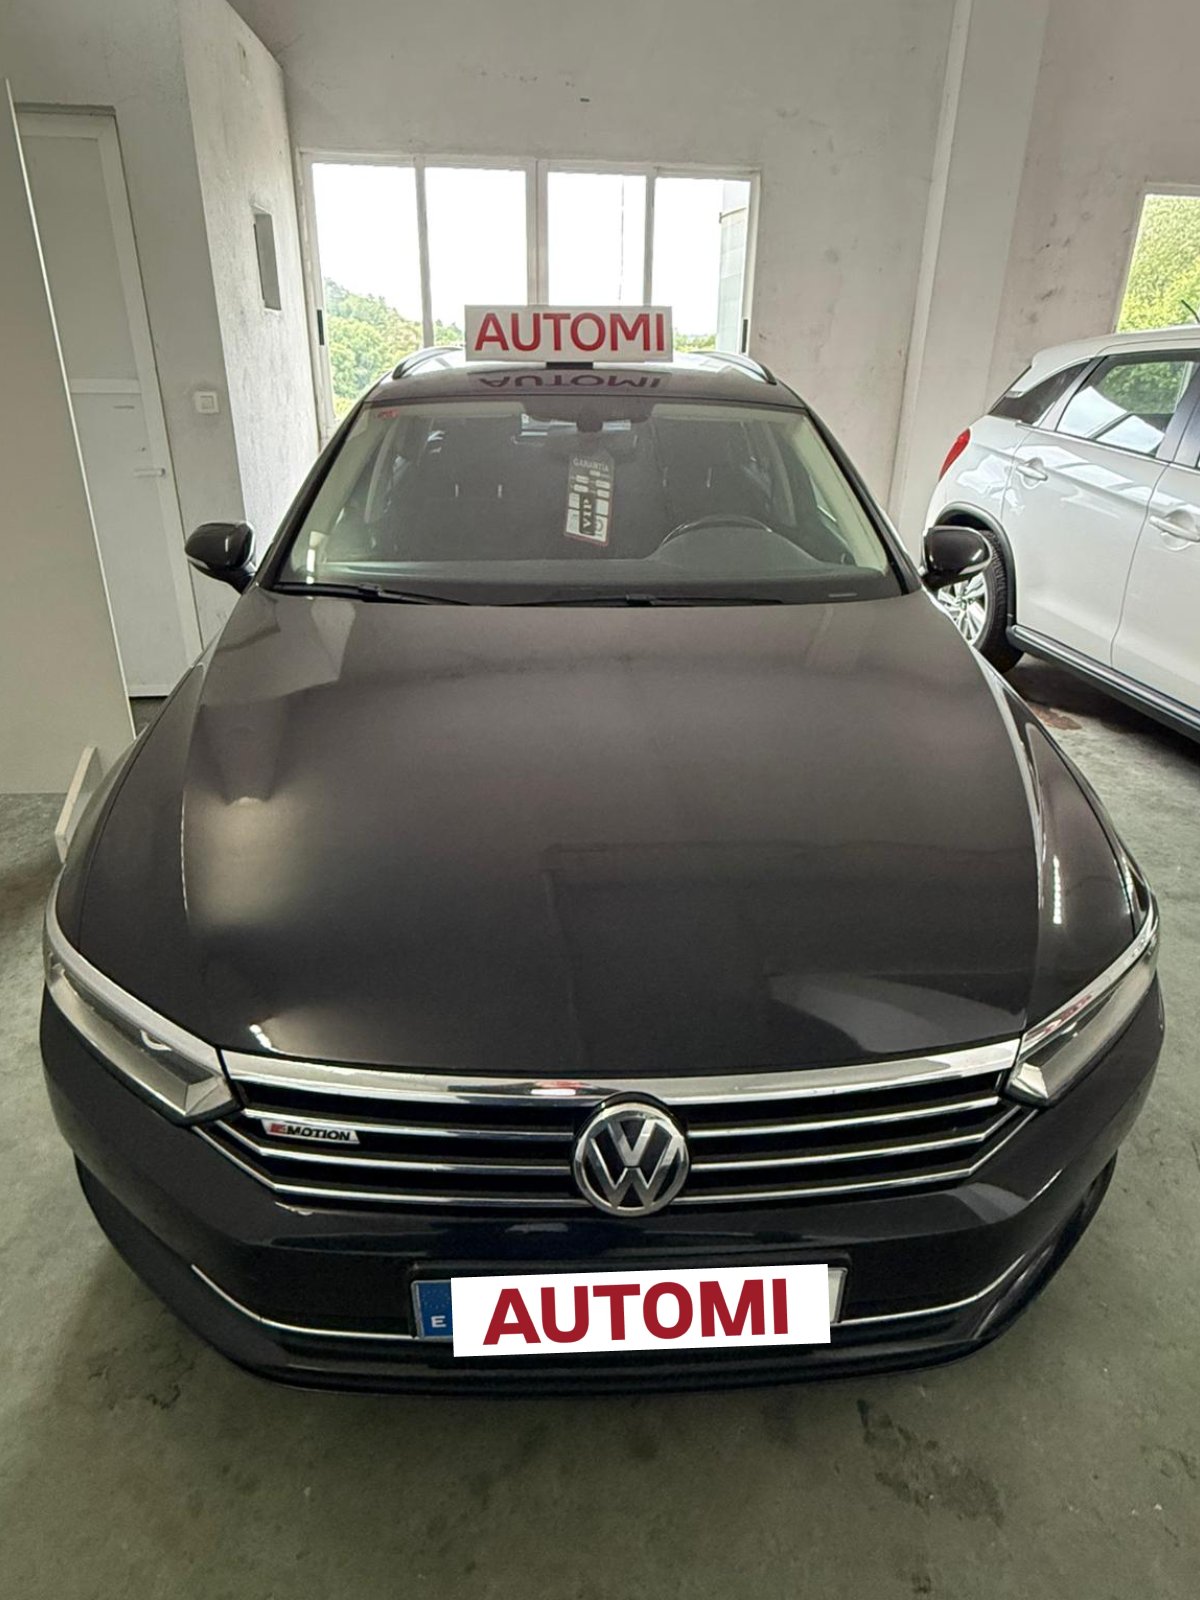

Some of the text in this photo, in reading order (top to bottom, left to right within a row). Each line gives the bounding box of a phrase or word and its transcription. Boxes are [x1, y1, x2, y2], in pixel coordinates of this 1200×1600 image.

[474, 312, 665, 351] AUTOMI
[582, 497, 593, 529] VIP
[431, 1315, 447, 1328] E
